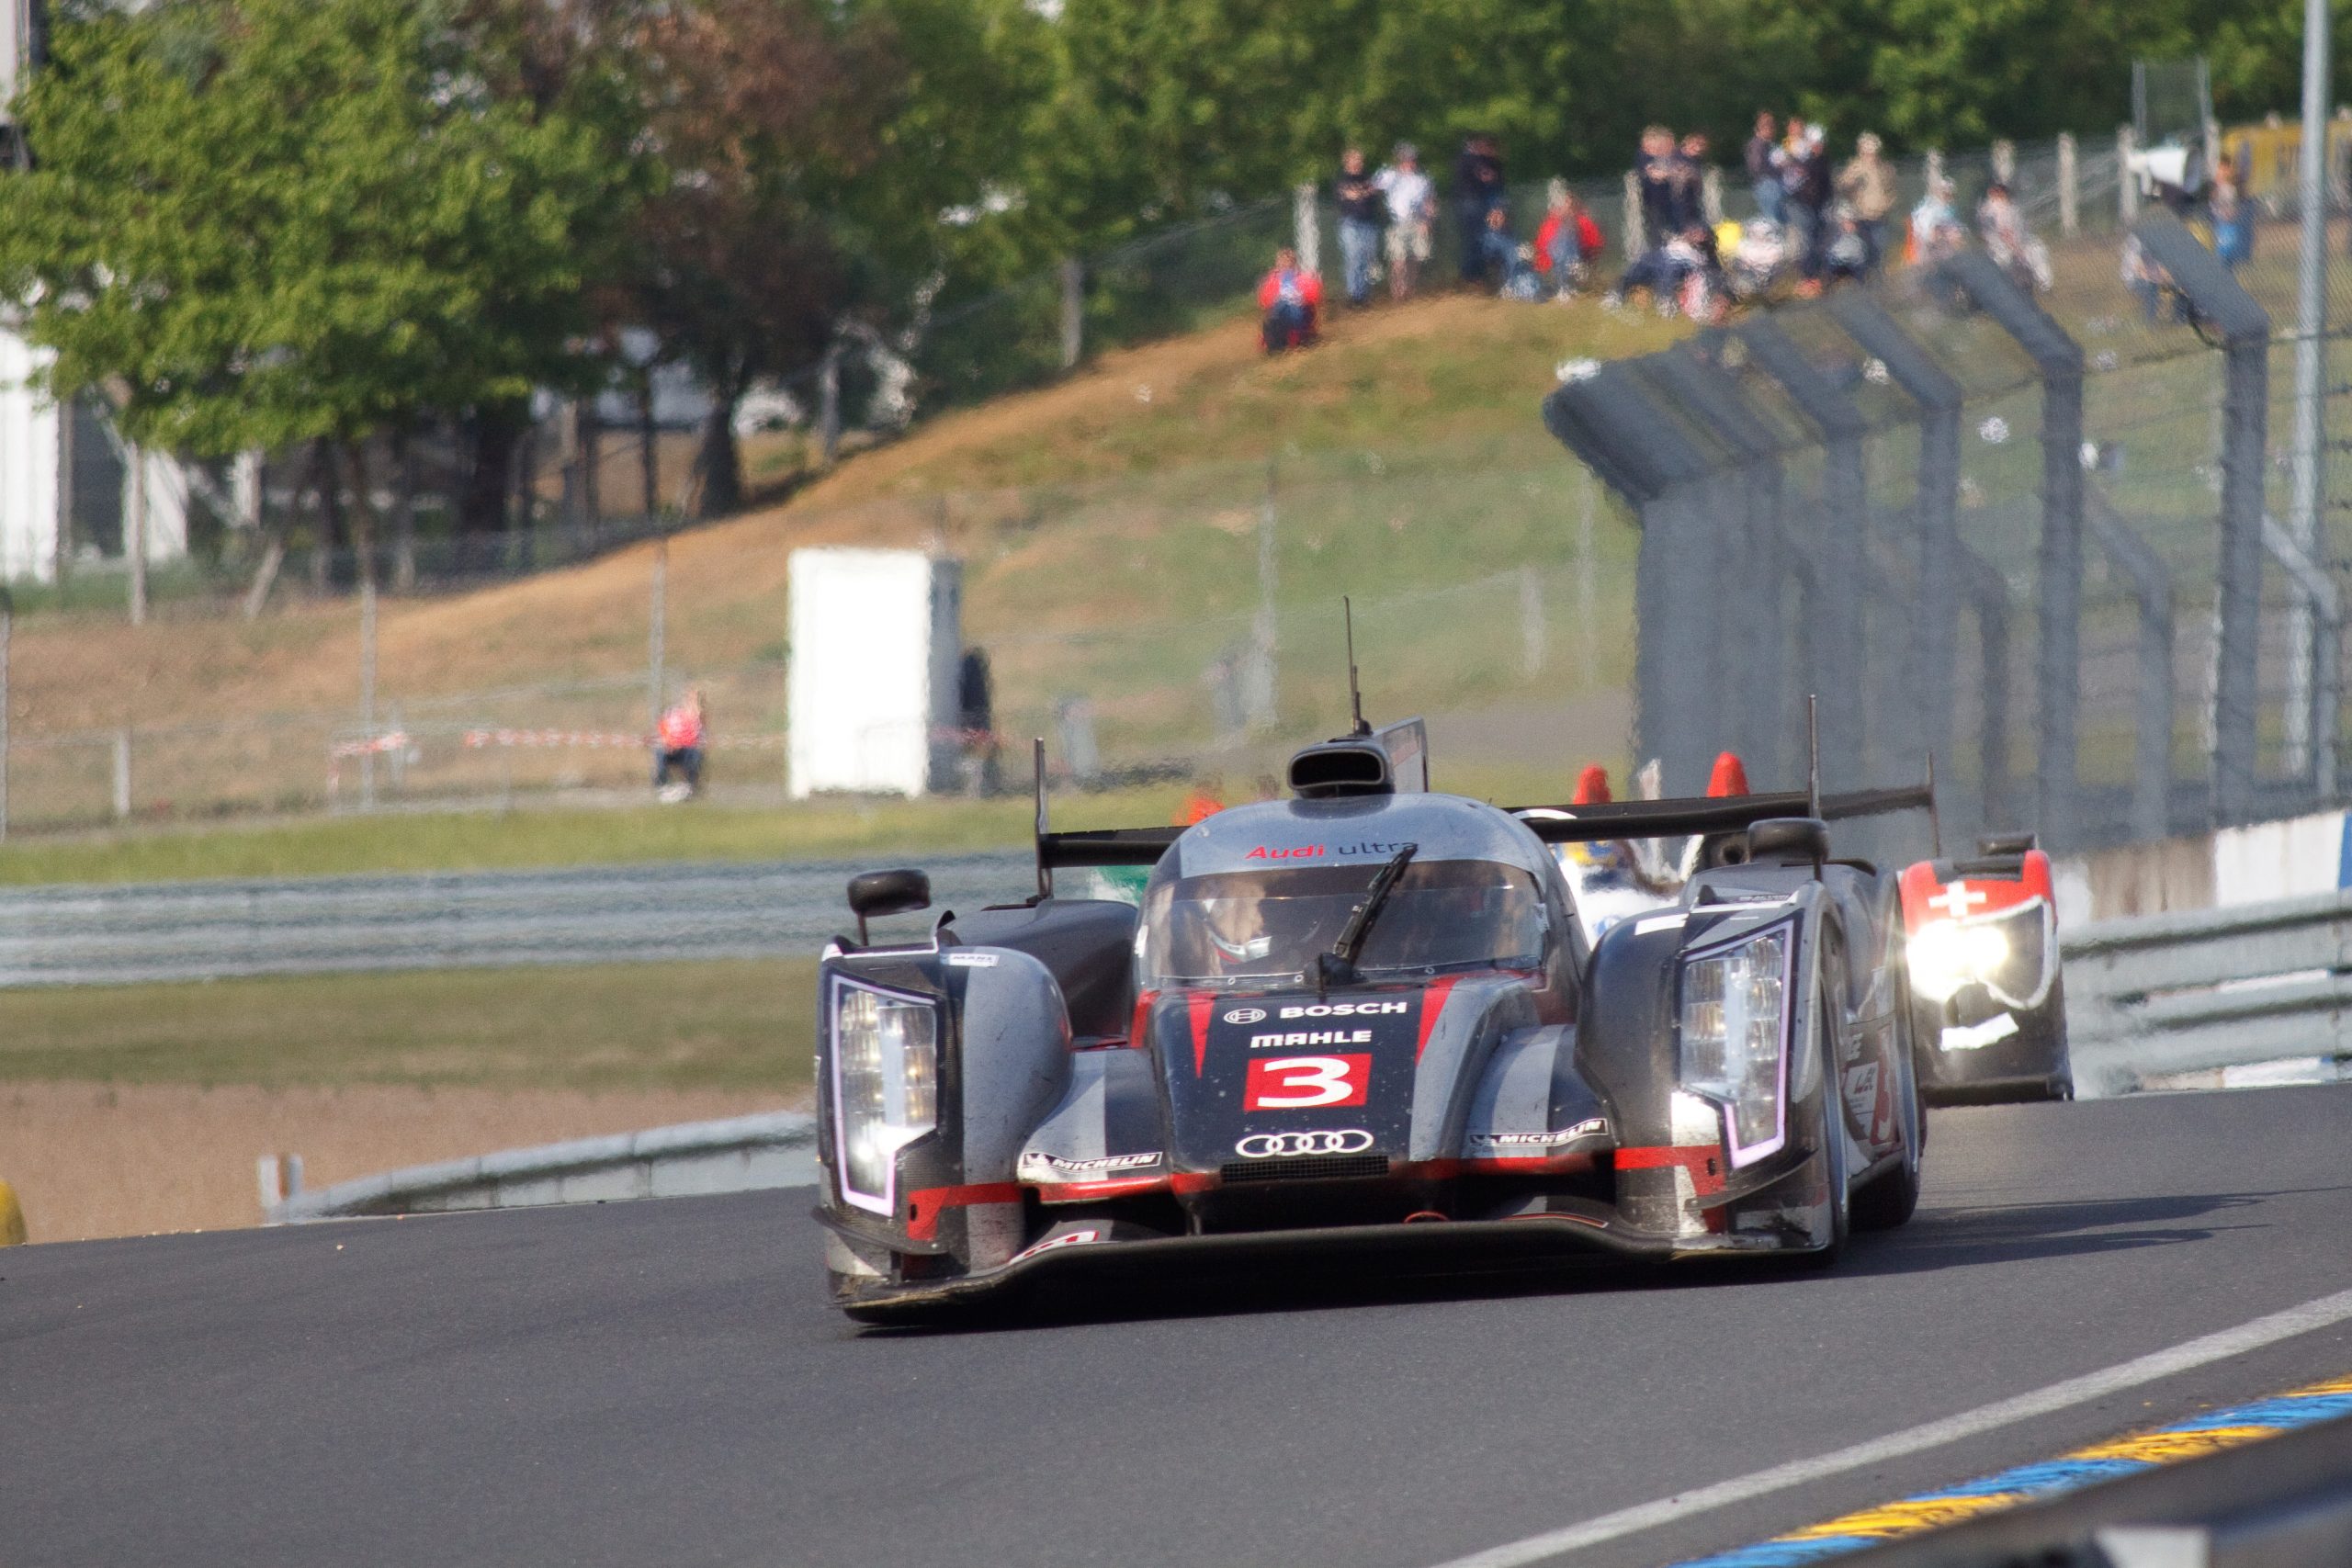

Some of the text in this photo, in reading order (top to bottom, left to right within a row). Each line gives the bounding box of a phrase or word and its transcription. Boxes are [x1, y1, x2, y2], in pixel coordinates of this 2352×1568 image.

[1245, 843, 1324, 860] Audi
[1280, 1001, 1408, 1019] BOSCH
[1250, 1030, 1373, 1049] MAHLE
[1257, 1057, 1353, 1108] 3
[1500, 1120, 1602, 1145] MICHELIN
[1051, 1154, 1156, 1171] MICHELIN
